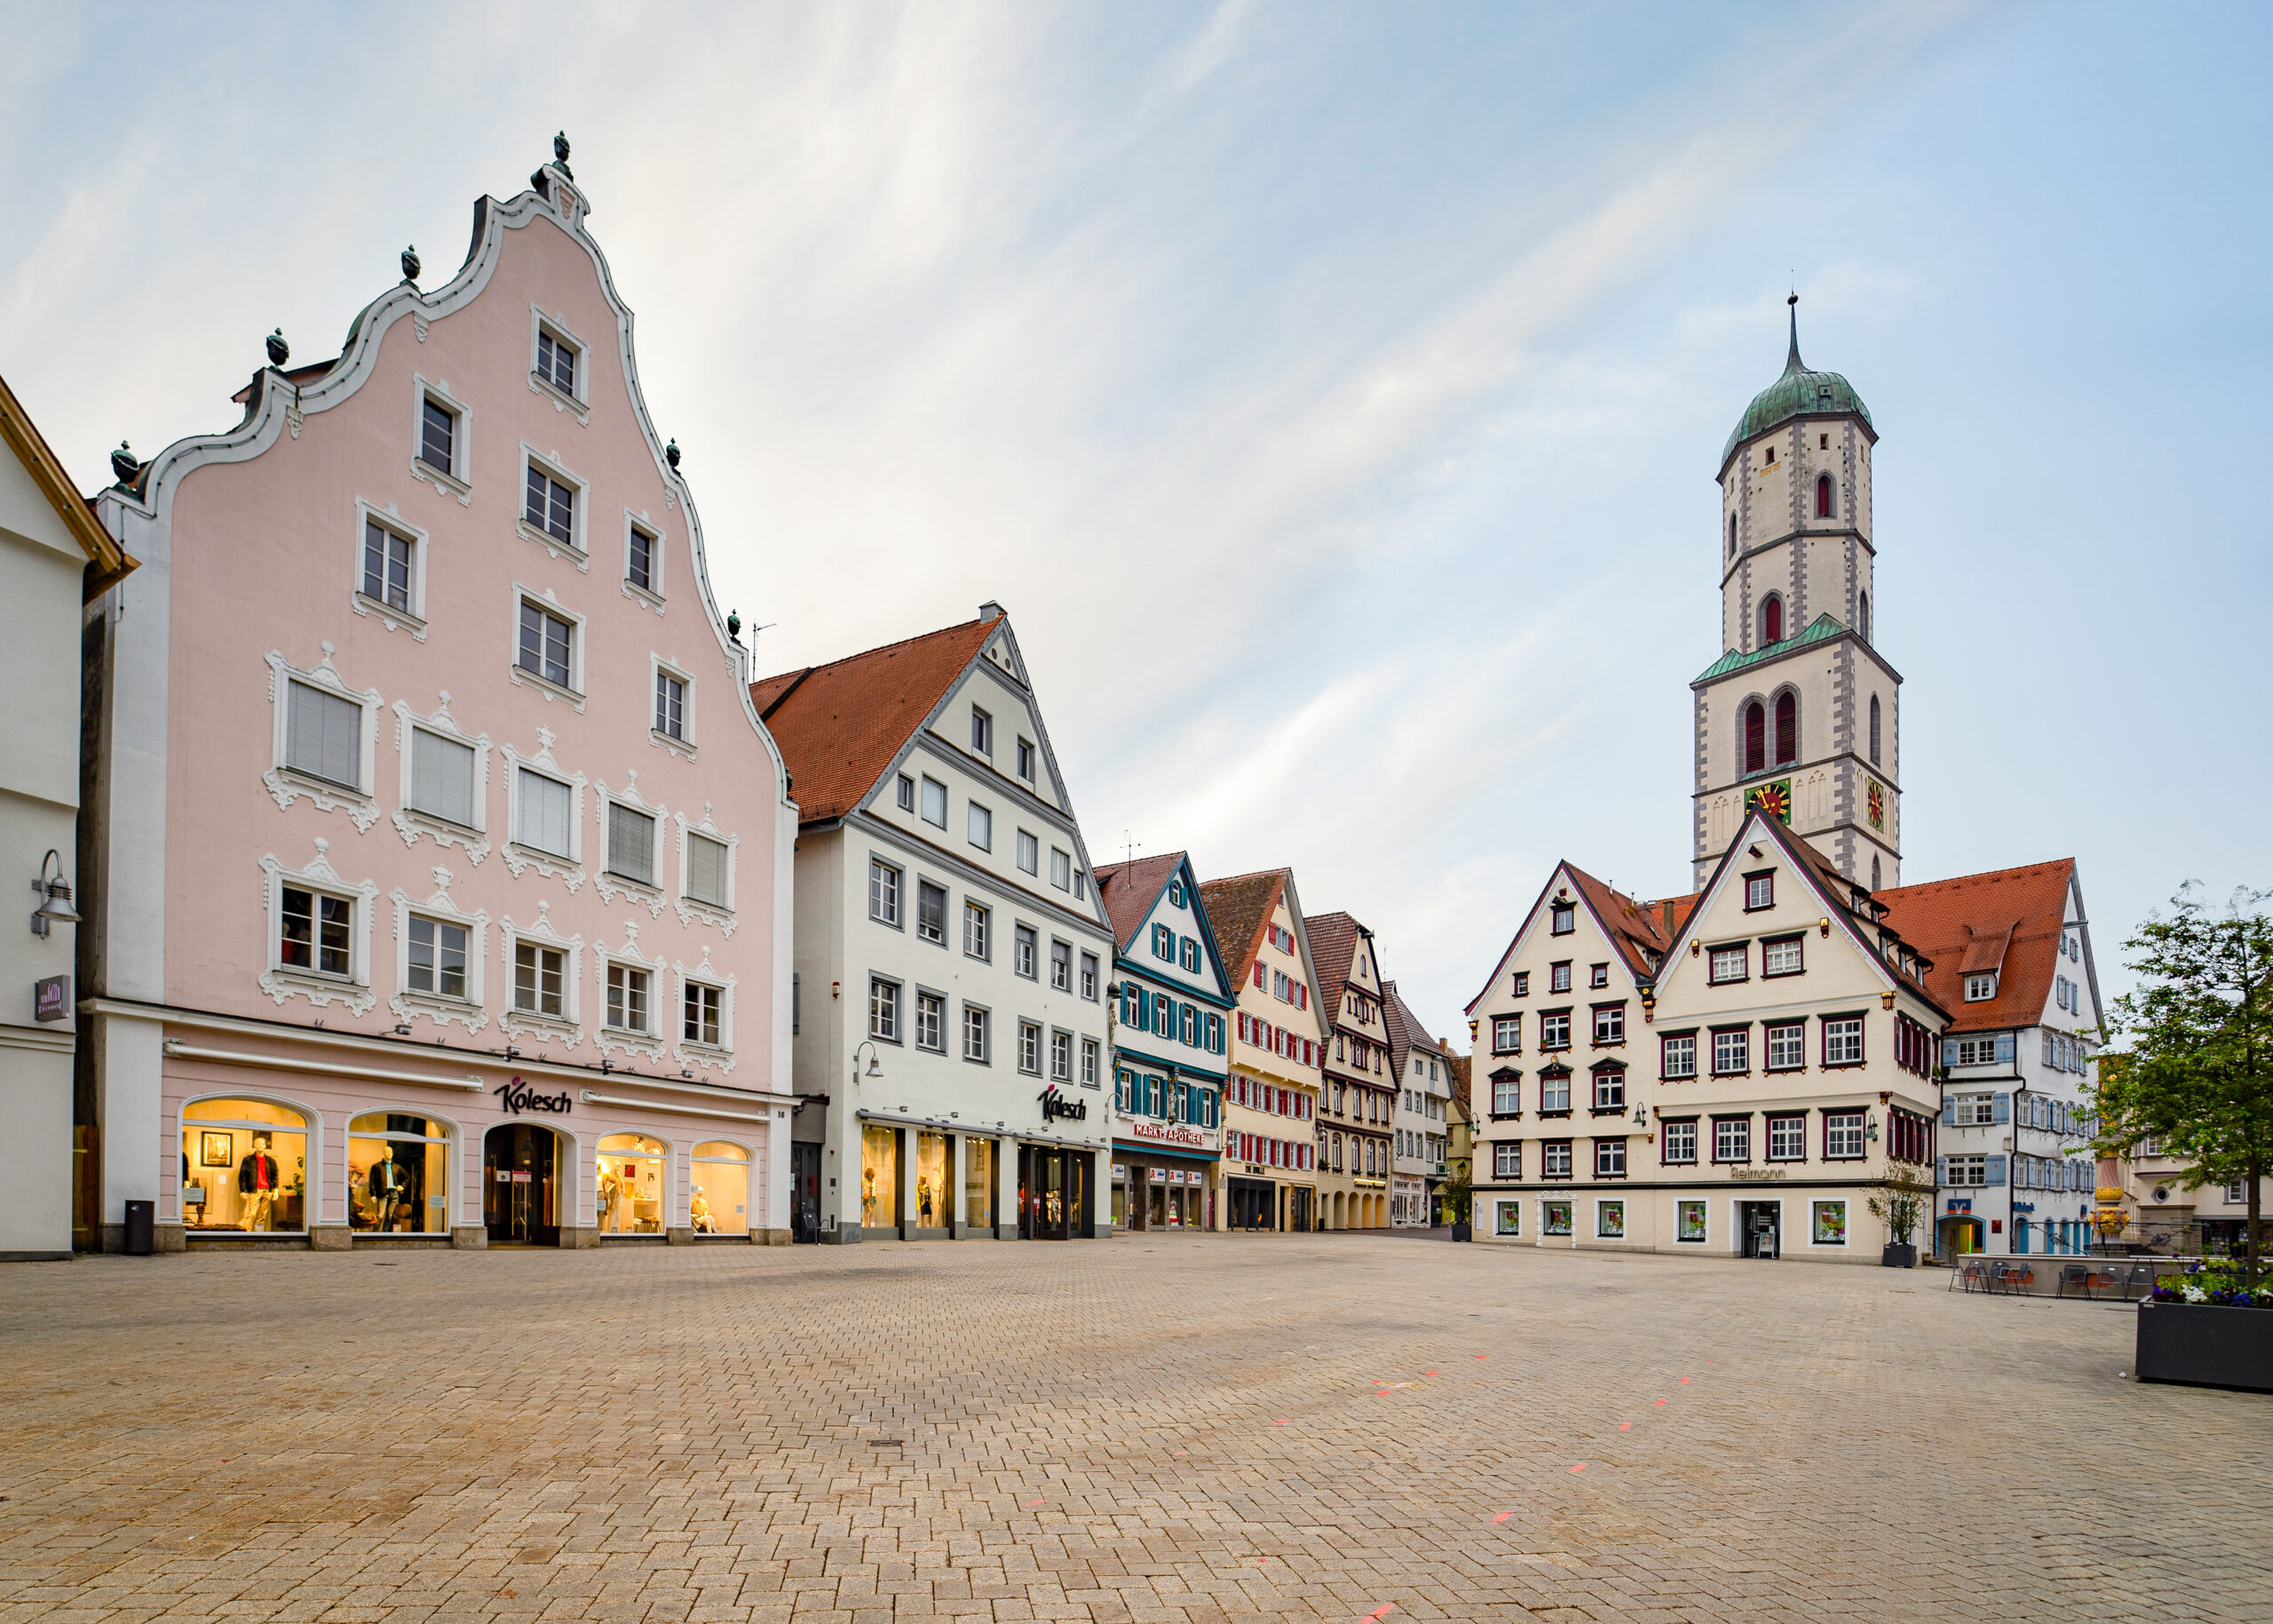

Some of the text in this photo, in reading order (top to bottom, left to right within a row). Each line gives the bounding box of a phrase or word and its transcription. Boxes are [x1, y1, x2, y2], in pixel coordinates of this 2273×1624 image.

[494, 1081, 572, 1114] Kolesch
[1037, 1088, 1086, 1123] Kolesch
[778, 1110, 786, 1119] 16
